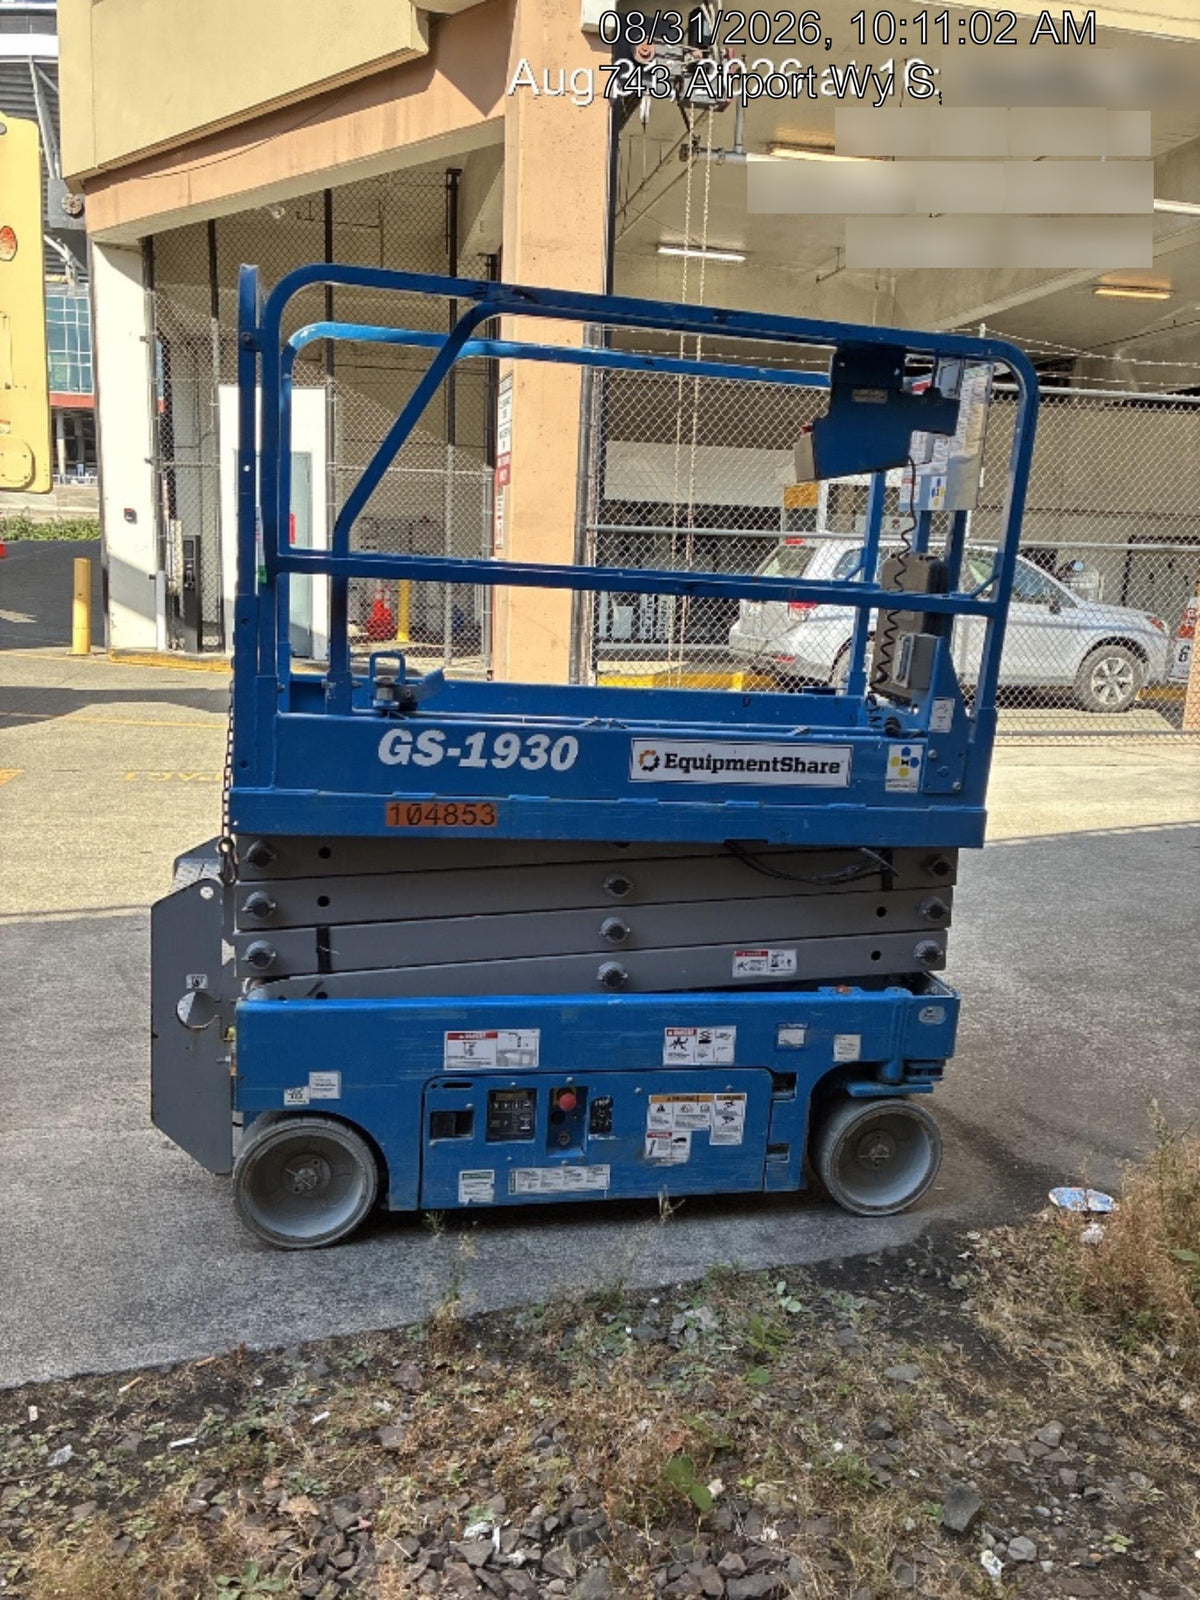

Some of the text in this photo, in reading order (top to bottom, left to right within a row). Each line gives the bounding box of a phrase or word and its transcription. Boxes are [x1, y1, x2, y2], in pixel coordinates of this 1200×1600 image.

[377, 727, 579, 772] GS-1930
[664, 752, 842, 775] EquipmentShare
[389, 802, 496, 826] 104853
